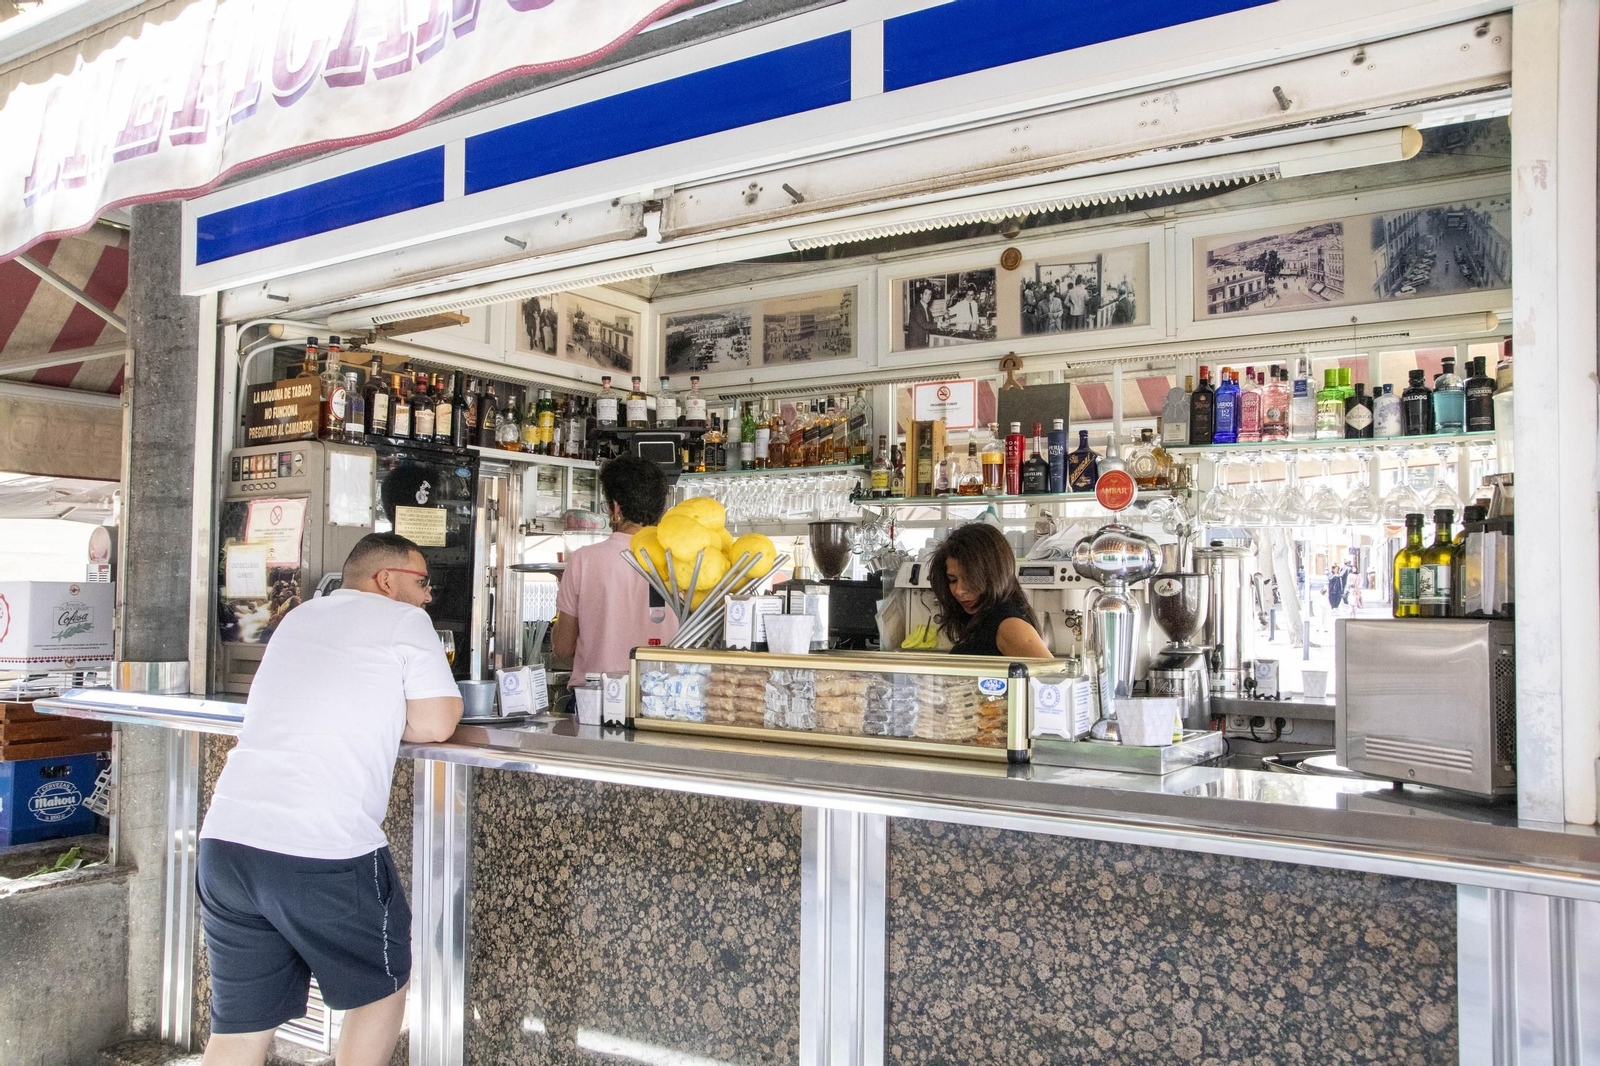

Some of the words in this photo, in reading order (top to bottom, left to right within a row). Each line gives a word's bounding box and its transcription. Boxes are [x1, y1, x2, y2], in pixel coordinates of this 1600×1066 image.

[261, 388, 283, 403] MAQUINA
[284, 387, 291, 400] DE
[292, 383, 312, 398] TABACO
[264, 407, 272, 420] NO
[273, 404, 298, 419] FUNCIONA
[249, 424, 277, 439] PREGUNTAR
[278, 423, 284, 436] AL
[285, 420, 313, 435] CAMARERO
[41, 782, 70, 791] CERVEZAS
[35, 796, 76, 808] Mahou
